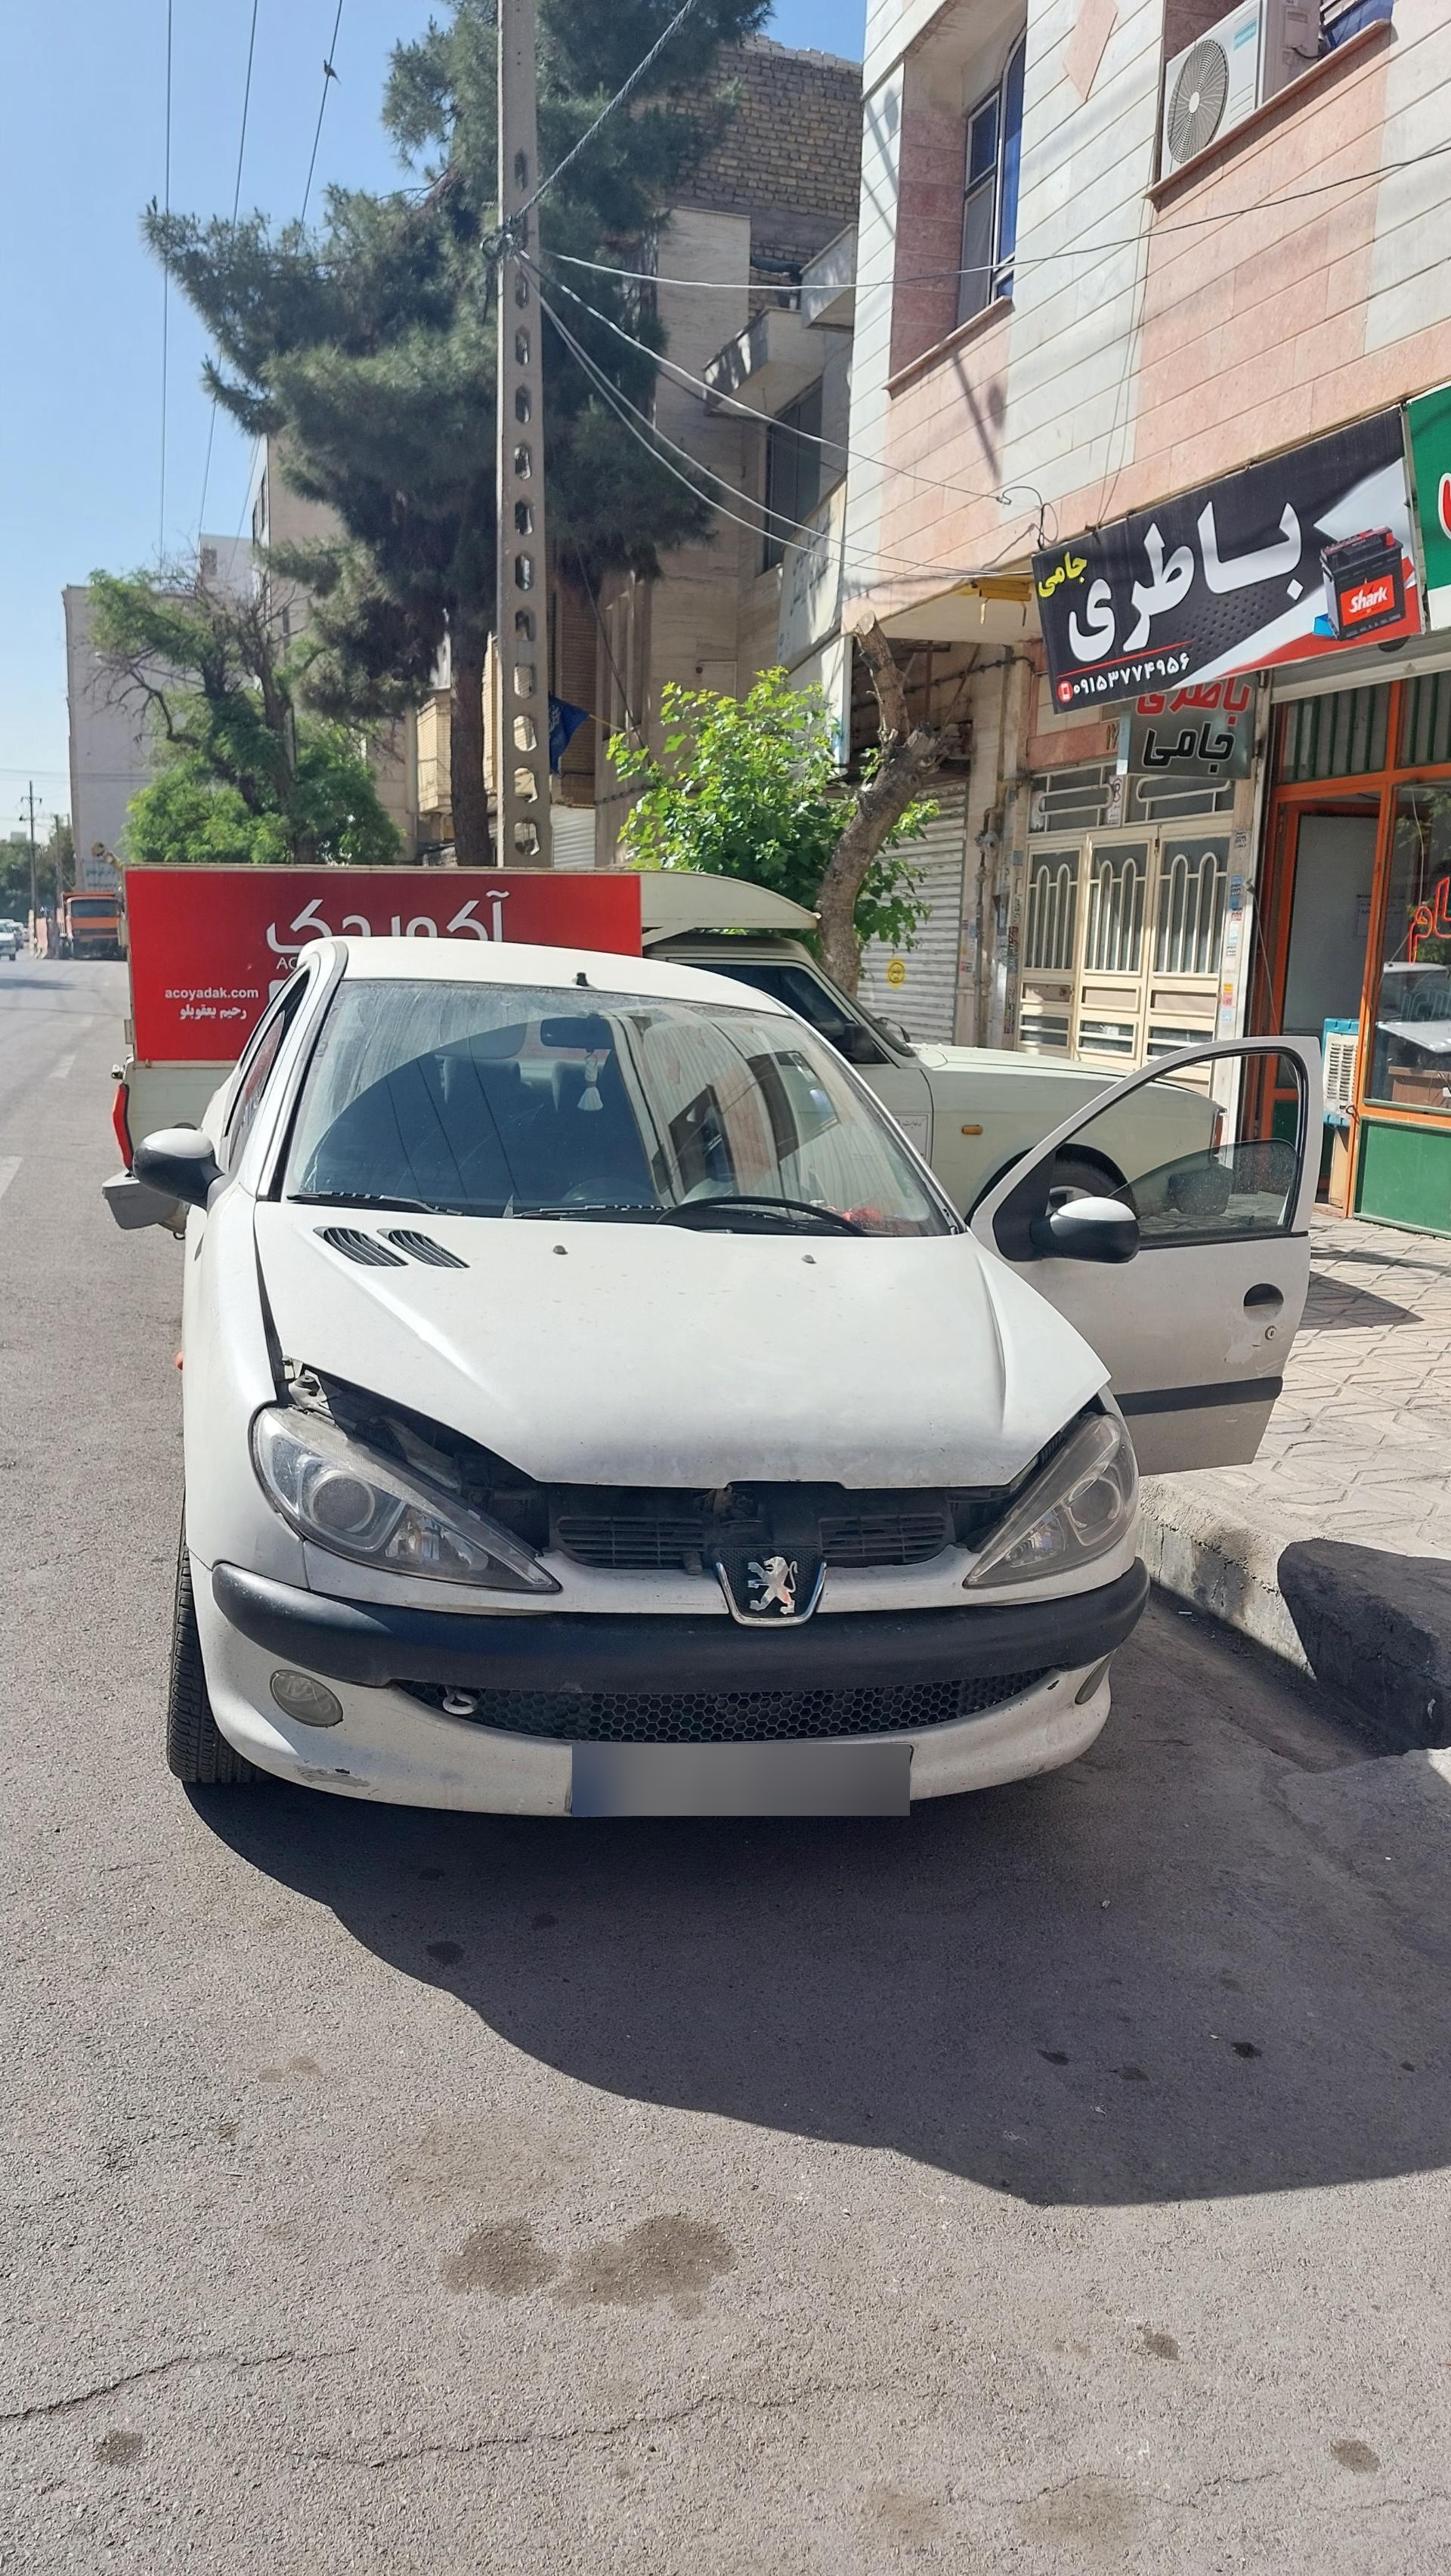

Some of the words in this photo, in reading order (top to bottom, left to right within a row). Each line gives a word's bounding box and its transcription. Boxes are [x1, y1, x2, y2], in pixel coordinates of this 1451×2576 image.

[1038, 551, 1088, 598] جامی
[1069, 500, 1304, 662] باطری
[1072, 651, 1190, 694] ۰۹۱۵۳۷۷۴۹۵۶
[1143, 721, 1236, 775] جامی
[165, 987, 259, 1001] acoyadak.com
[219, 1007, 247, 1020] رحیم
